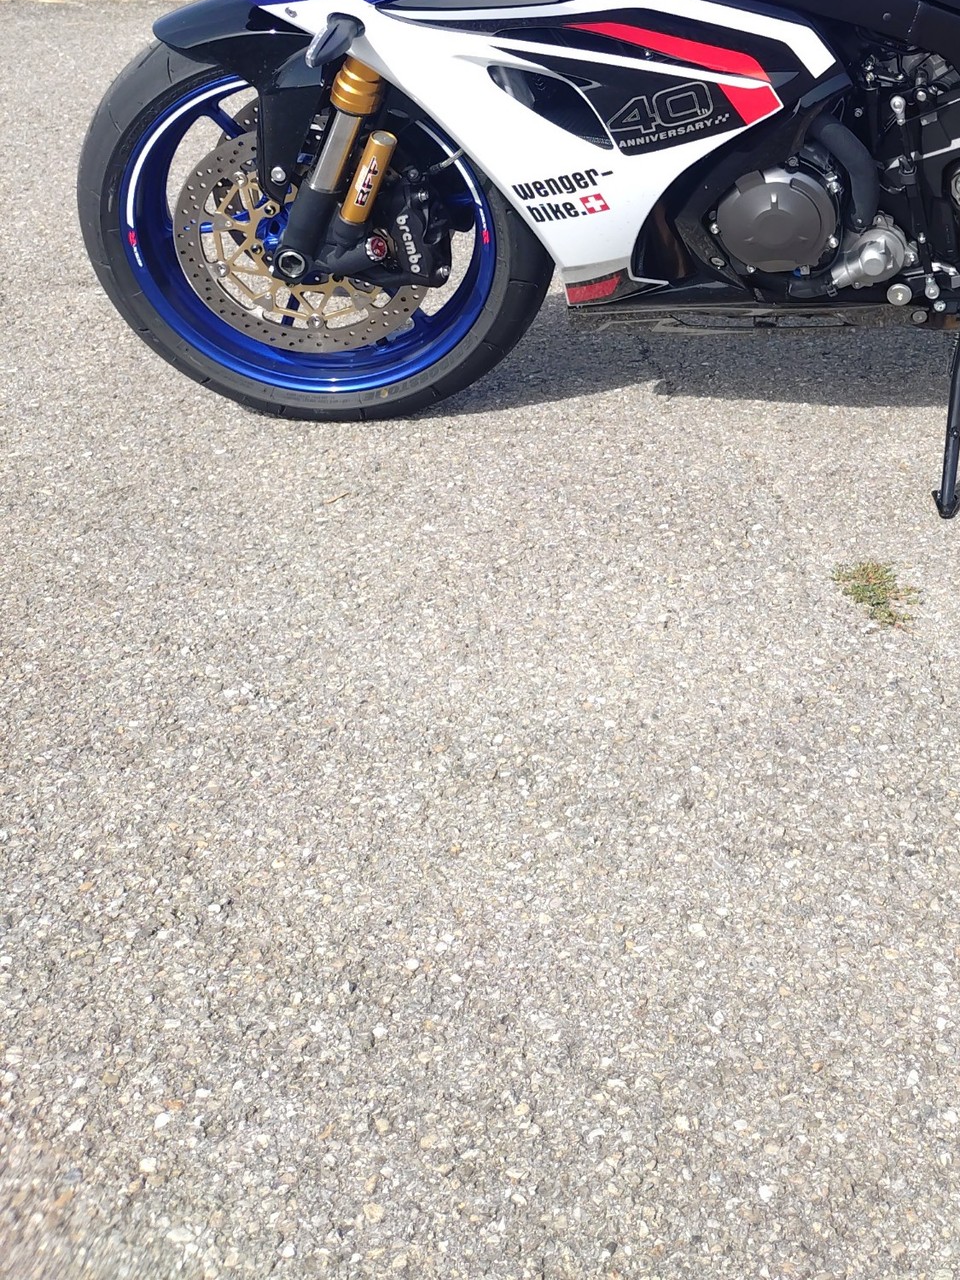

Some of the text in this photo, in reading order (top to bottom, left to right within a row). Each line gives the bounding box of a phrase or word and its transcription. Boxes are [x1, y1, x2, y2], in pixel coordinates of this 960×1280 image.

[618, 119, 713, 149] ANNIVERSARY
[511, 168, 614, 201] wenger-
[526, 201, 588, 223] bike.
[396, 214, 421, 274] brembo
